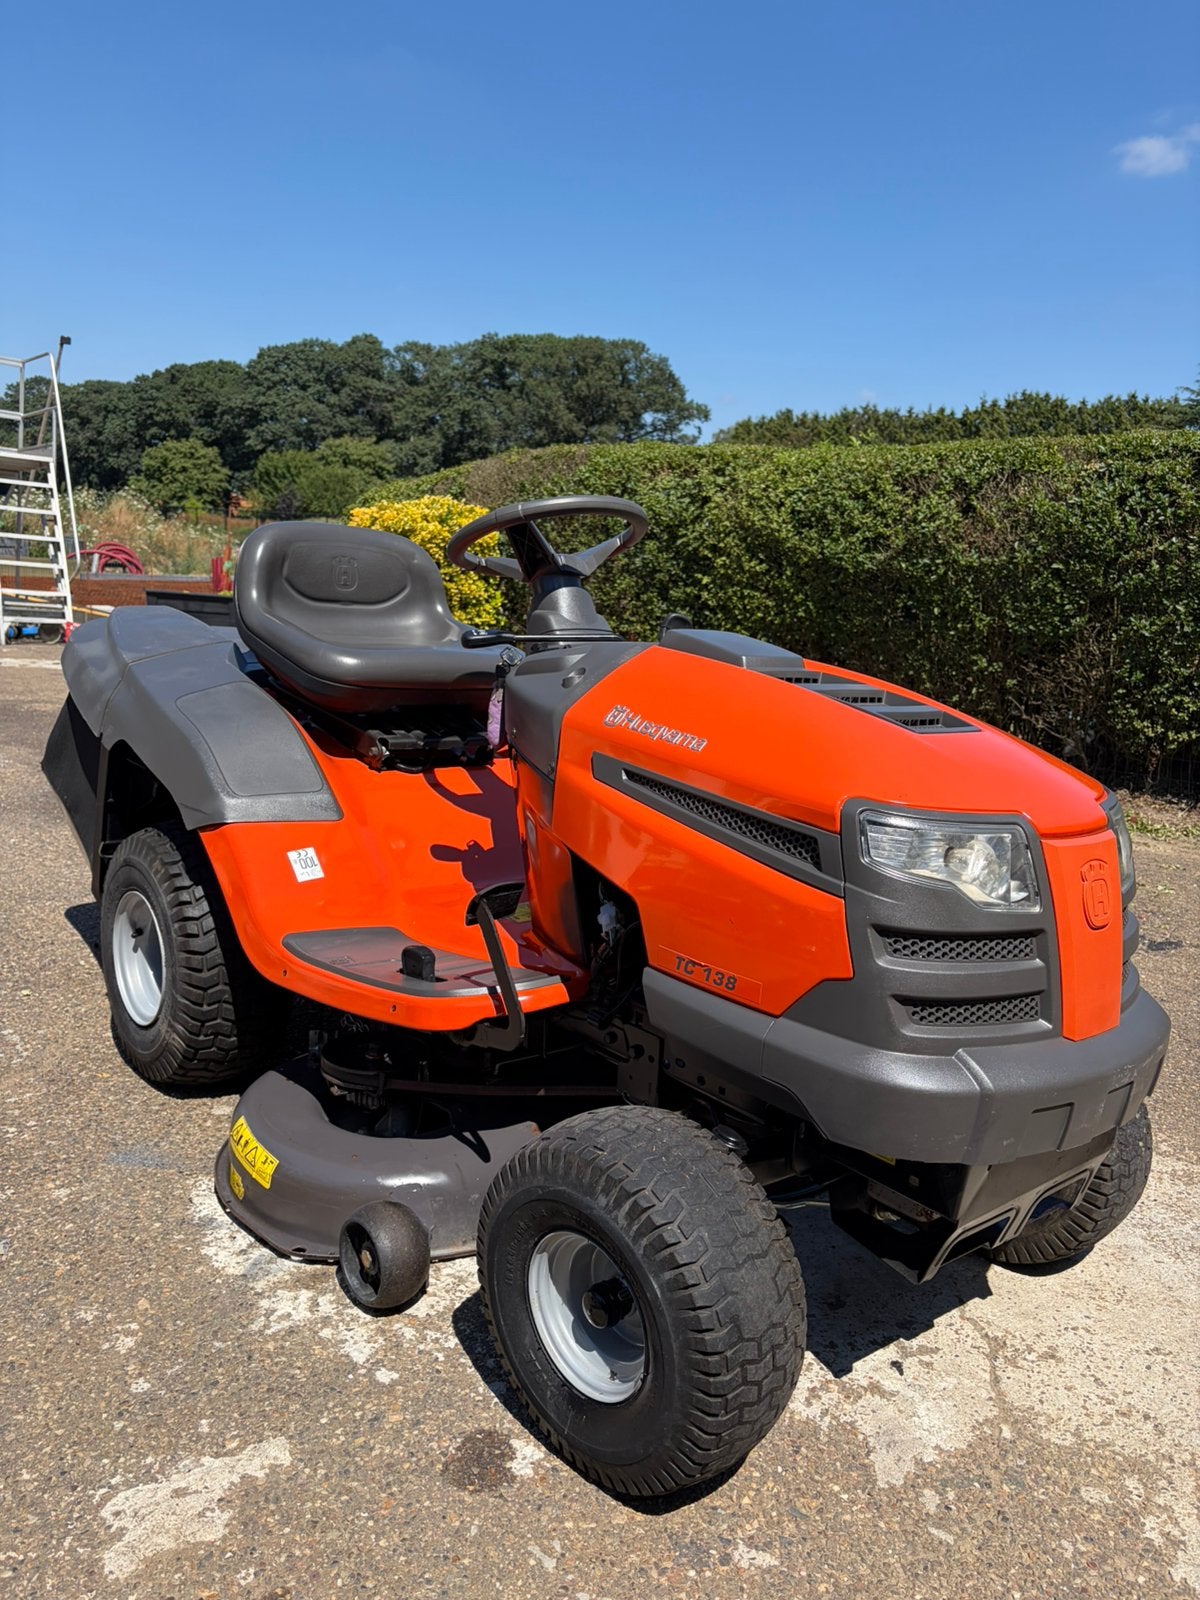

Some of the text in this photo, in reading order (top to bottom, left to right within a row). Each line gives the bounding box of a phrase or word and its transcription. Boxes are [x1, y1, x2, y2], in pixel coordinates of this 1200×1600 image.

[621, 711, 708, 752] Husqvarna
[298, 856, 318, 870] 100
[675, 955, 738, 991] TC 138
